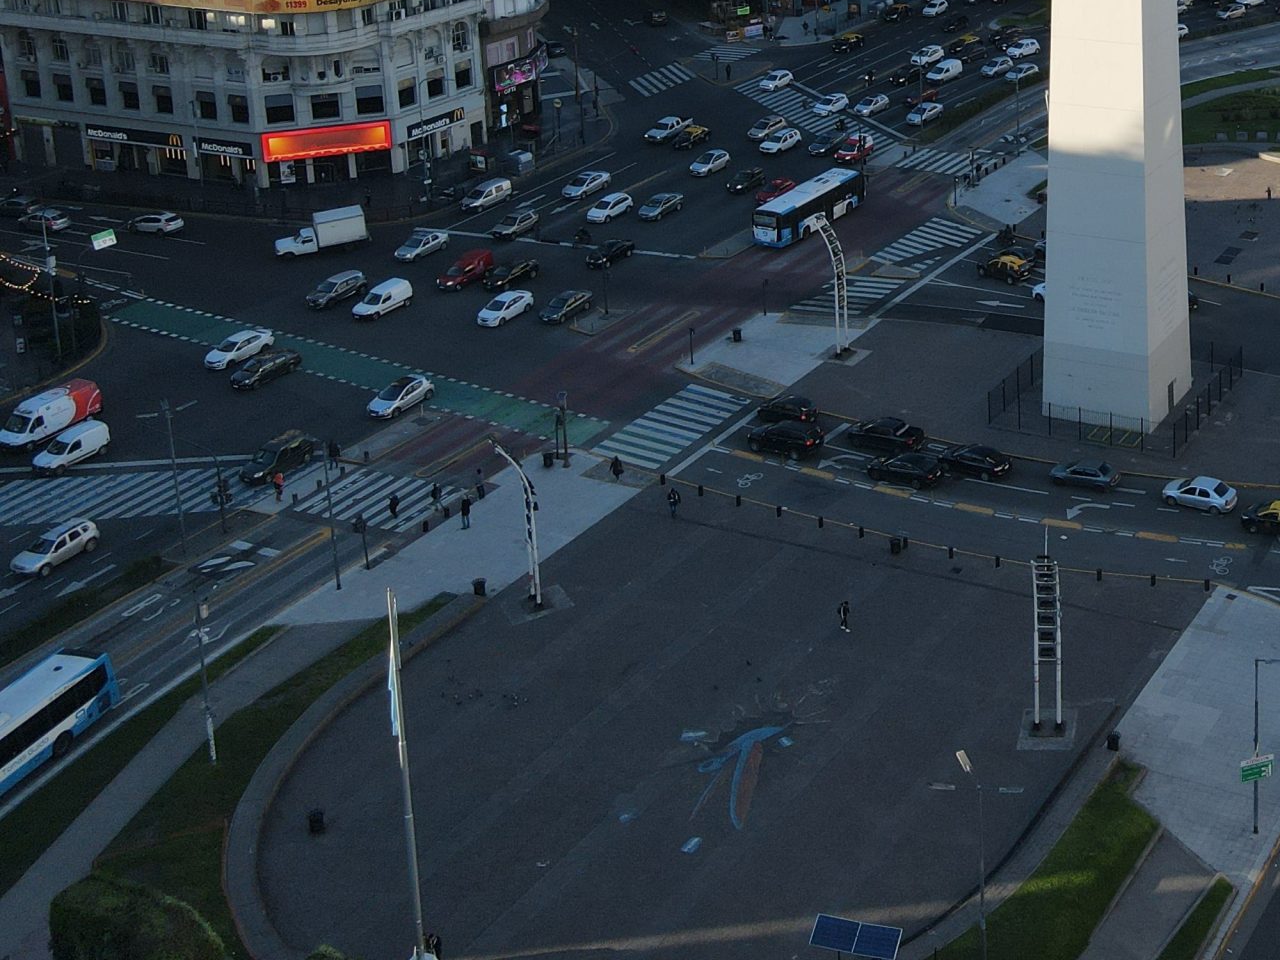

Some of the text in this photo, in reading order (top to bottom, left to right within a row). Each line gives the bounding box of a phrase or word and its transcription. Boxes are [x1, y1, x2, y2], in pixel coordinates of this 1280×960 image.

[411, 117, 450, 137] McDonald's
[87, 128, 128, 140] McDonald's
[201, 142, 243, 155] McDonald's
